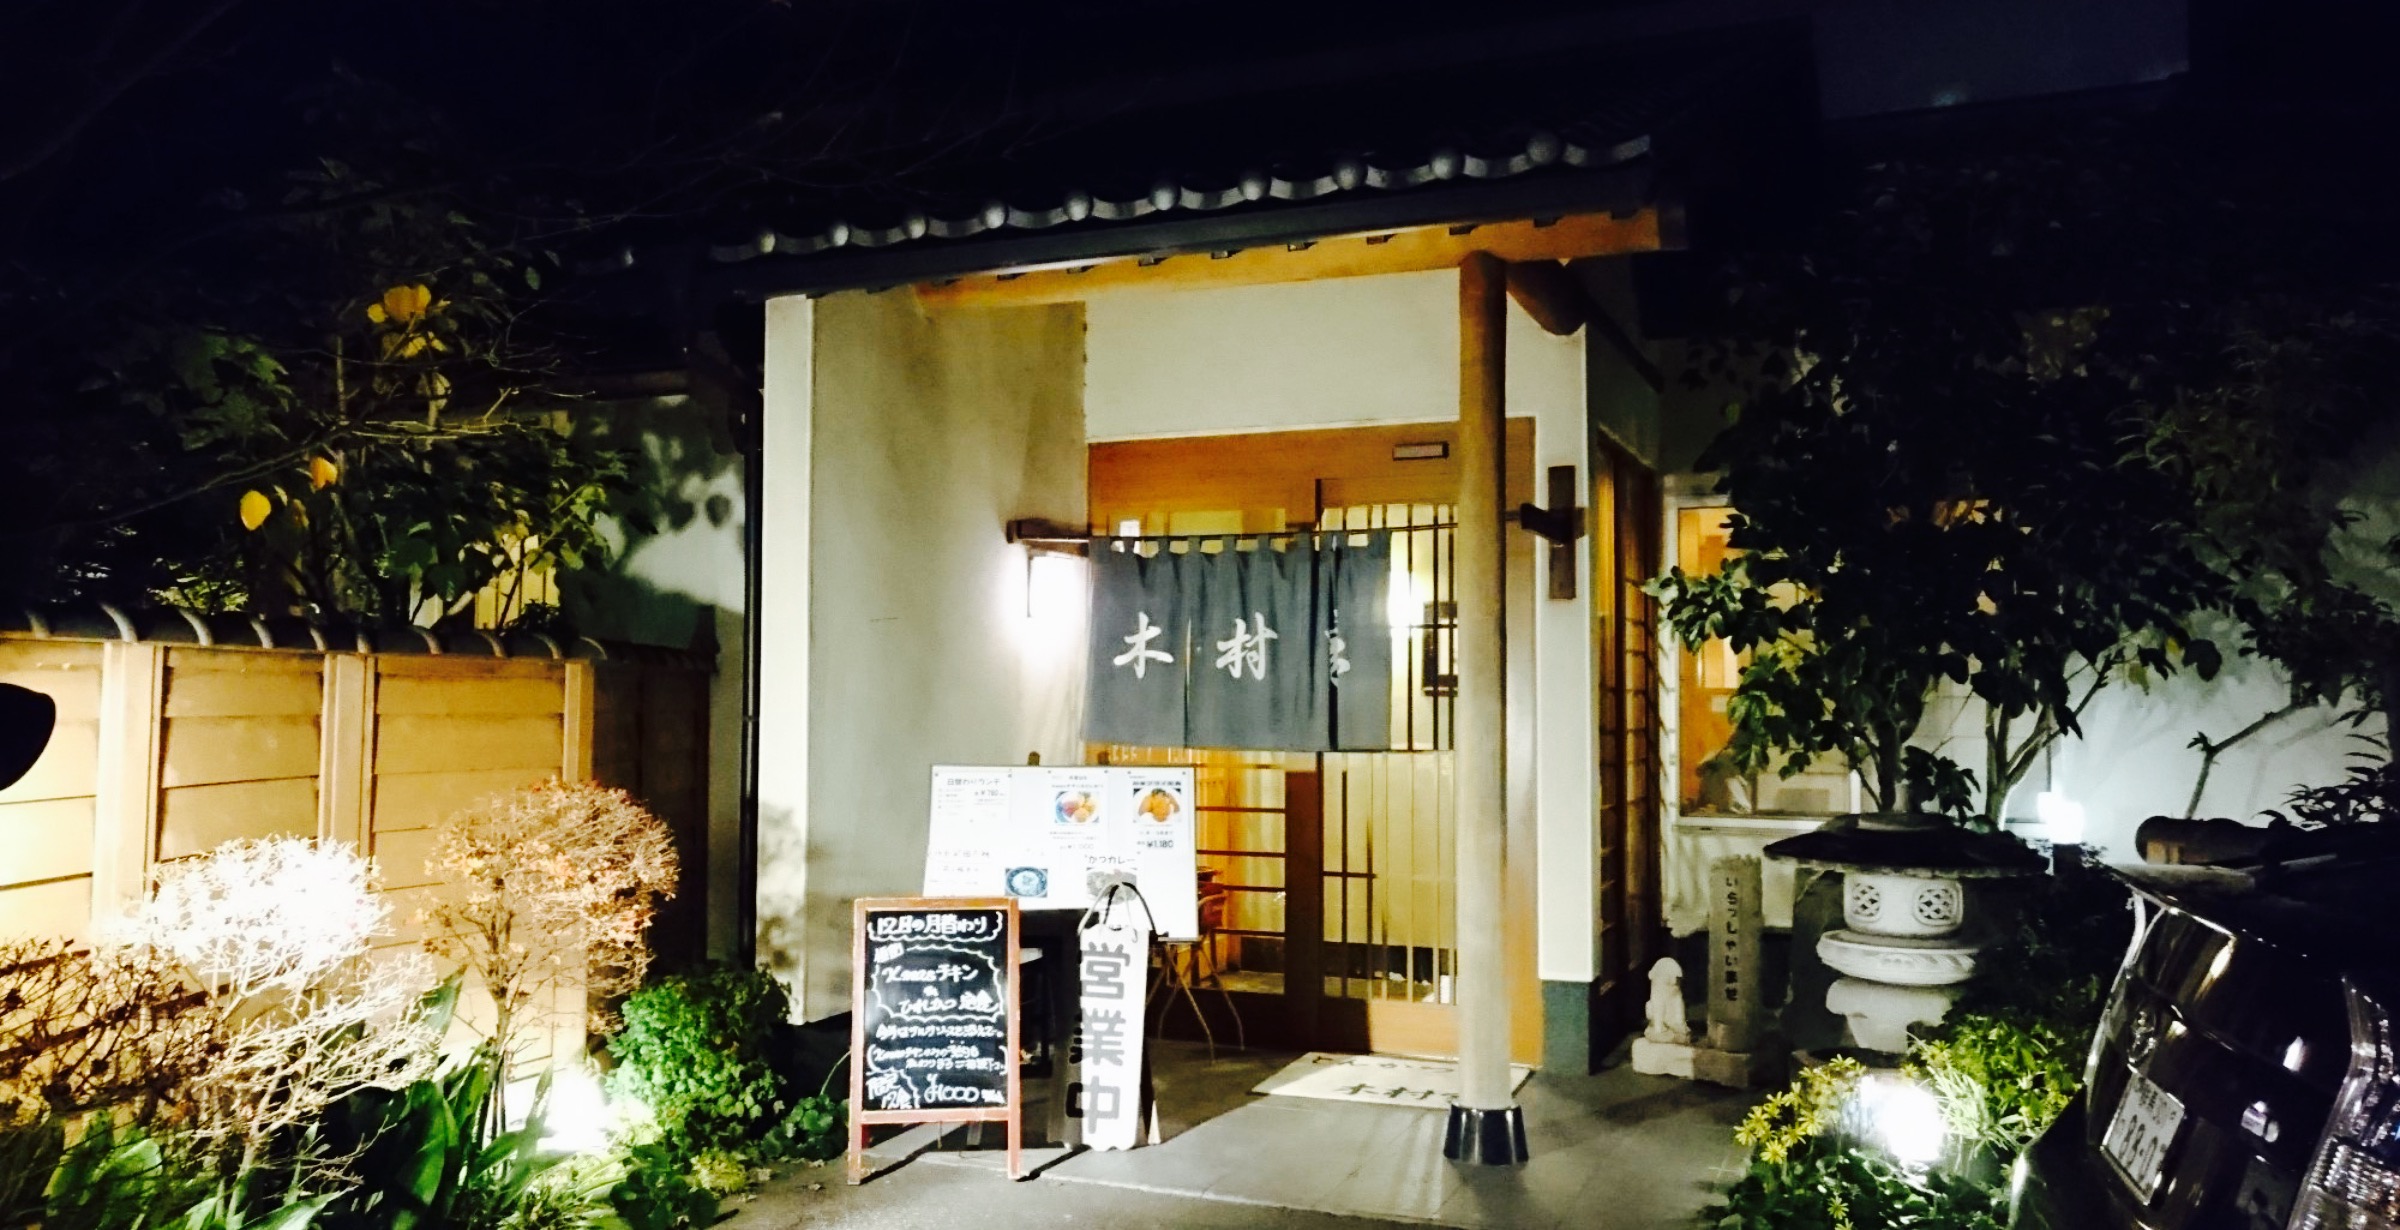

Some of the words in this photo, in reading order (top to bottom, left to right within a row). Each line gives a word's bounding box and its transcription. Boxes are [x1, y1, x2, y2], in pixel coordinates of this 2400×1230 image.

[877, 913, 987, 935] 12月の月替わり
[1065, 941, 1131, 1135] 営業中
